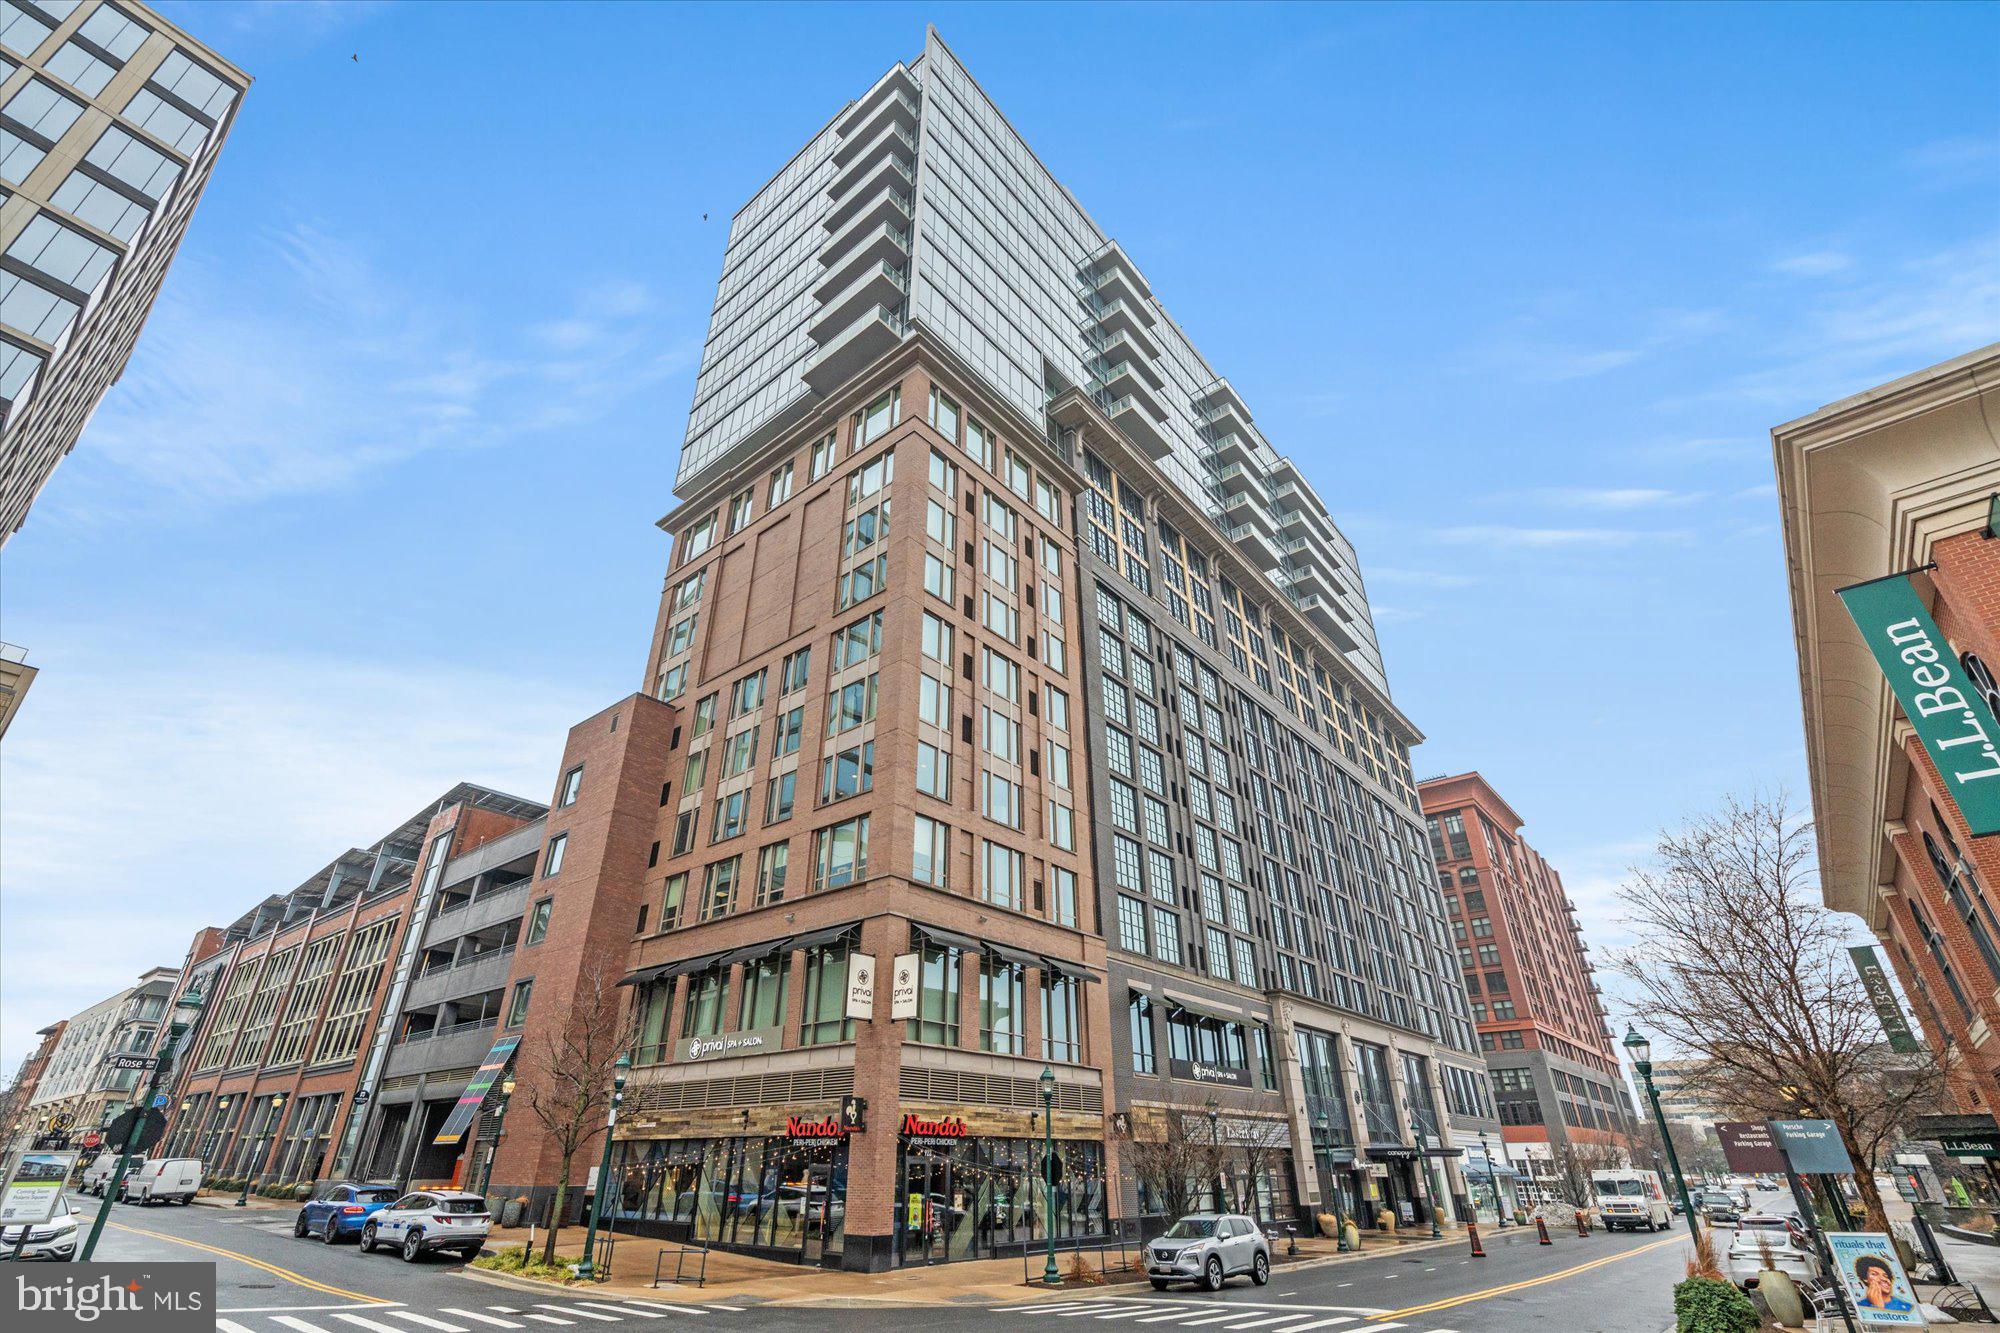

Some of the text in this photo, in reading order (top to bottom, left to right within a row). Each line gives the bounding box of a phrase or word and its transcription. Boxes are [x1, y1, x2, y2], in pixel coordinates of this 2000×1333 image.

[1886, 617, 2000, 784] L.L.Bean
[852, 986, 872, 997] privai
[894, 985, 913, 999] privai
[701, 1037, 724, 1057] privai
[727, 1039, 737, 1049] SPA
[743, 1037, 762, 1047] SALON
[118, 1058, 143, 1068] Rose
[1201, 1065, 1215, 1080] privai
[784, 1115, 845, 1137] Nando
[903, 1113, 967, 1137] Nando's
[793, 1137, 839, 1146] PERI-PERI CHICKEN
[911, 1137, 957, 1146] PERI-PERI CHICKEN
[1942, 1141, 1994, 1151] L.L.Bean
[1387, 1150, 1412, 1159] canopy
[1834, 1240, 1887, 1249] rituals that
[1872, 1312, 1909, 1321] restore
